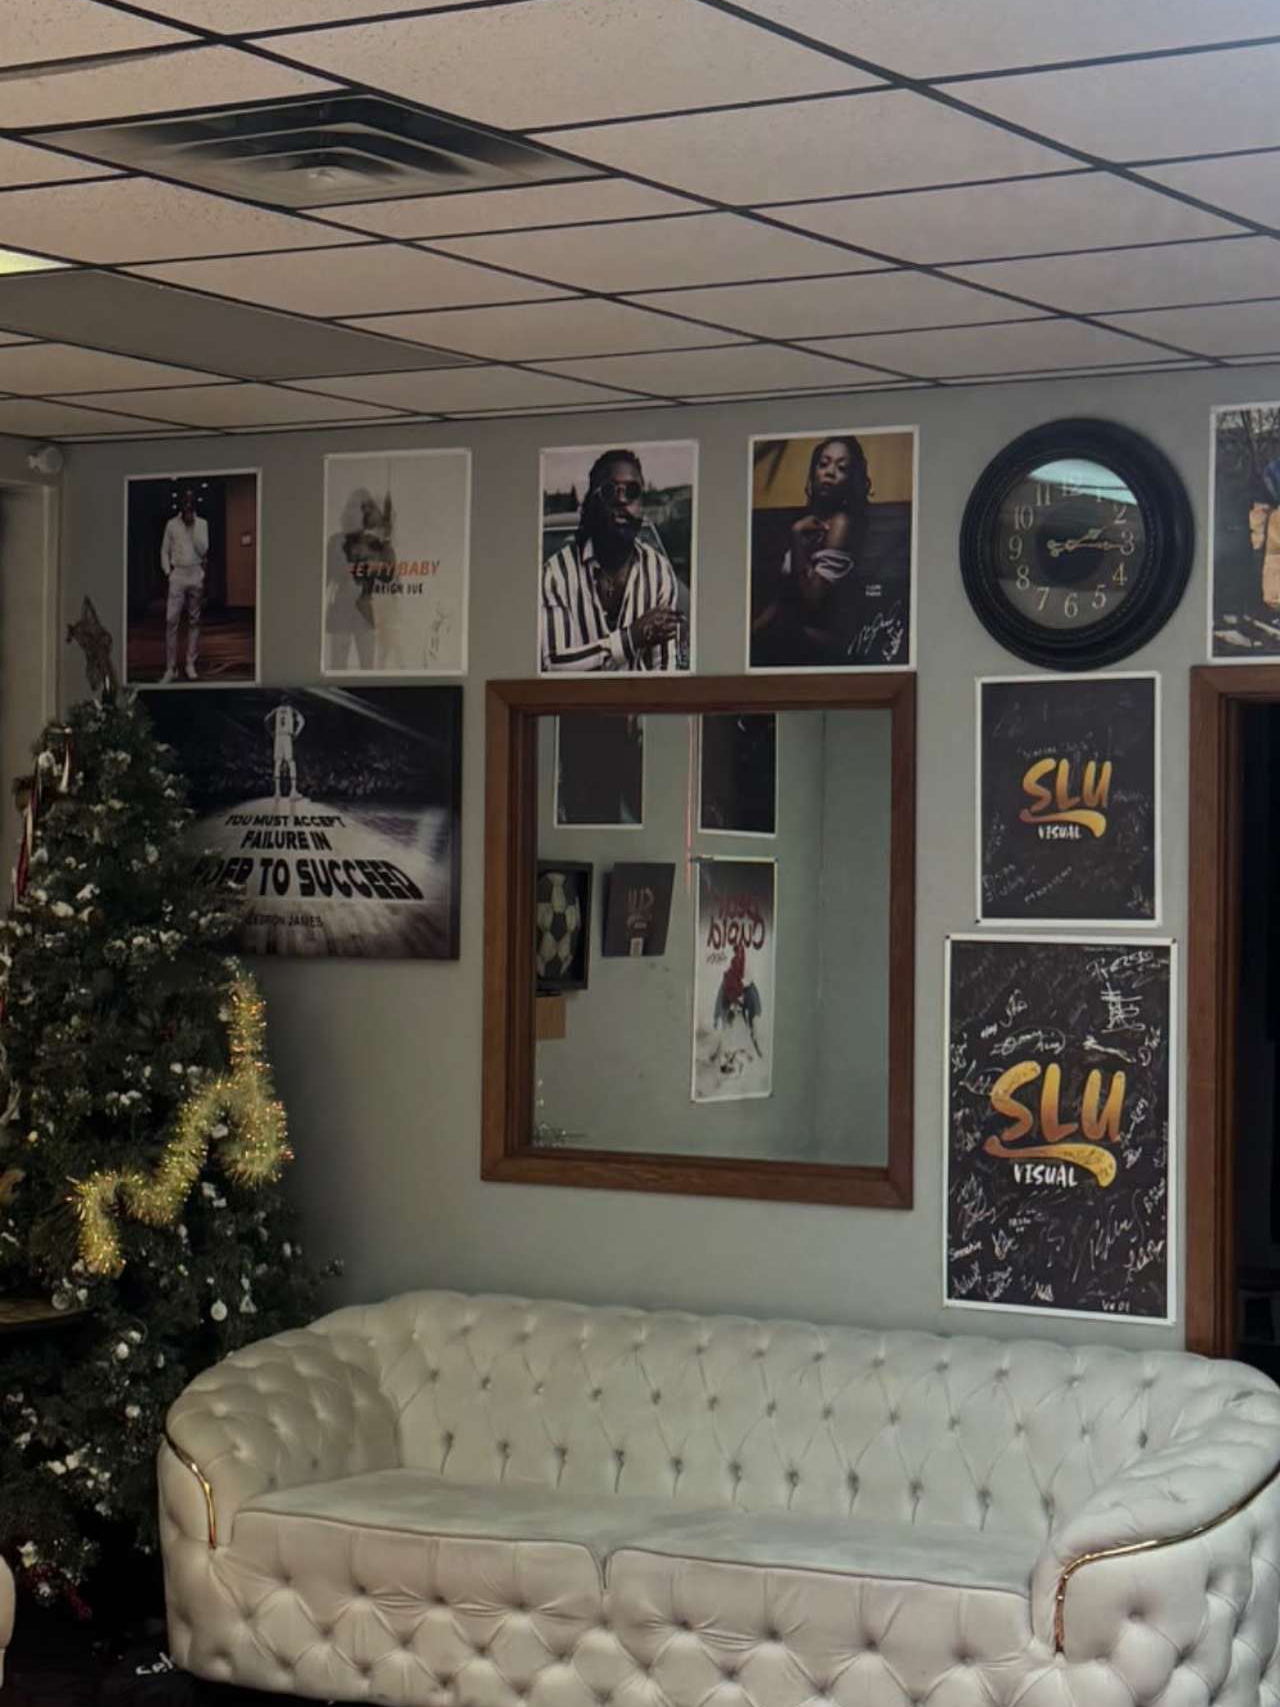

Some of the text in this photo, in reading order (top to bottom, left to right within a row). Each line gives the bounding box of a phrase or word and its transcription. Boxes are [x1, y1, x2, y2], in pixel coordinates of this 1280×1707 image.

[1035, 483, 1052, 507] 11
[1013, 505, 1035, 530] 10
[1112, 504, 1128, 525] 2
[1008, 535, 1024, 561] 9
[1119, 531, 1136, 556] 3
[398, 560, 441, 576] BABY
[1015, 564, 1031, 591] 8
[1111, 562, 1128, 587] 4
[1036, 586, 1051, 611] 7
[1064, 592, 1079, 619] 6
[1091, 584, 1108, 610] 5
[1022, 757, 1113, 814] SLU
[224, 814, 346, 828] YOU MUST ACCEPT
[240, 830, 333, 851] FAILURE IN
[259, 857, 291, 897] TO
[295, 857, 424, 900] SUCCEED
[990, 1060, 1126, 1143] SLU
[1013, 1162, 1078, 1188] VISUAL
